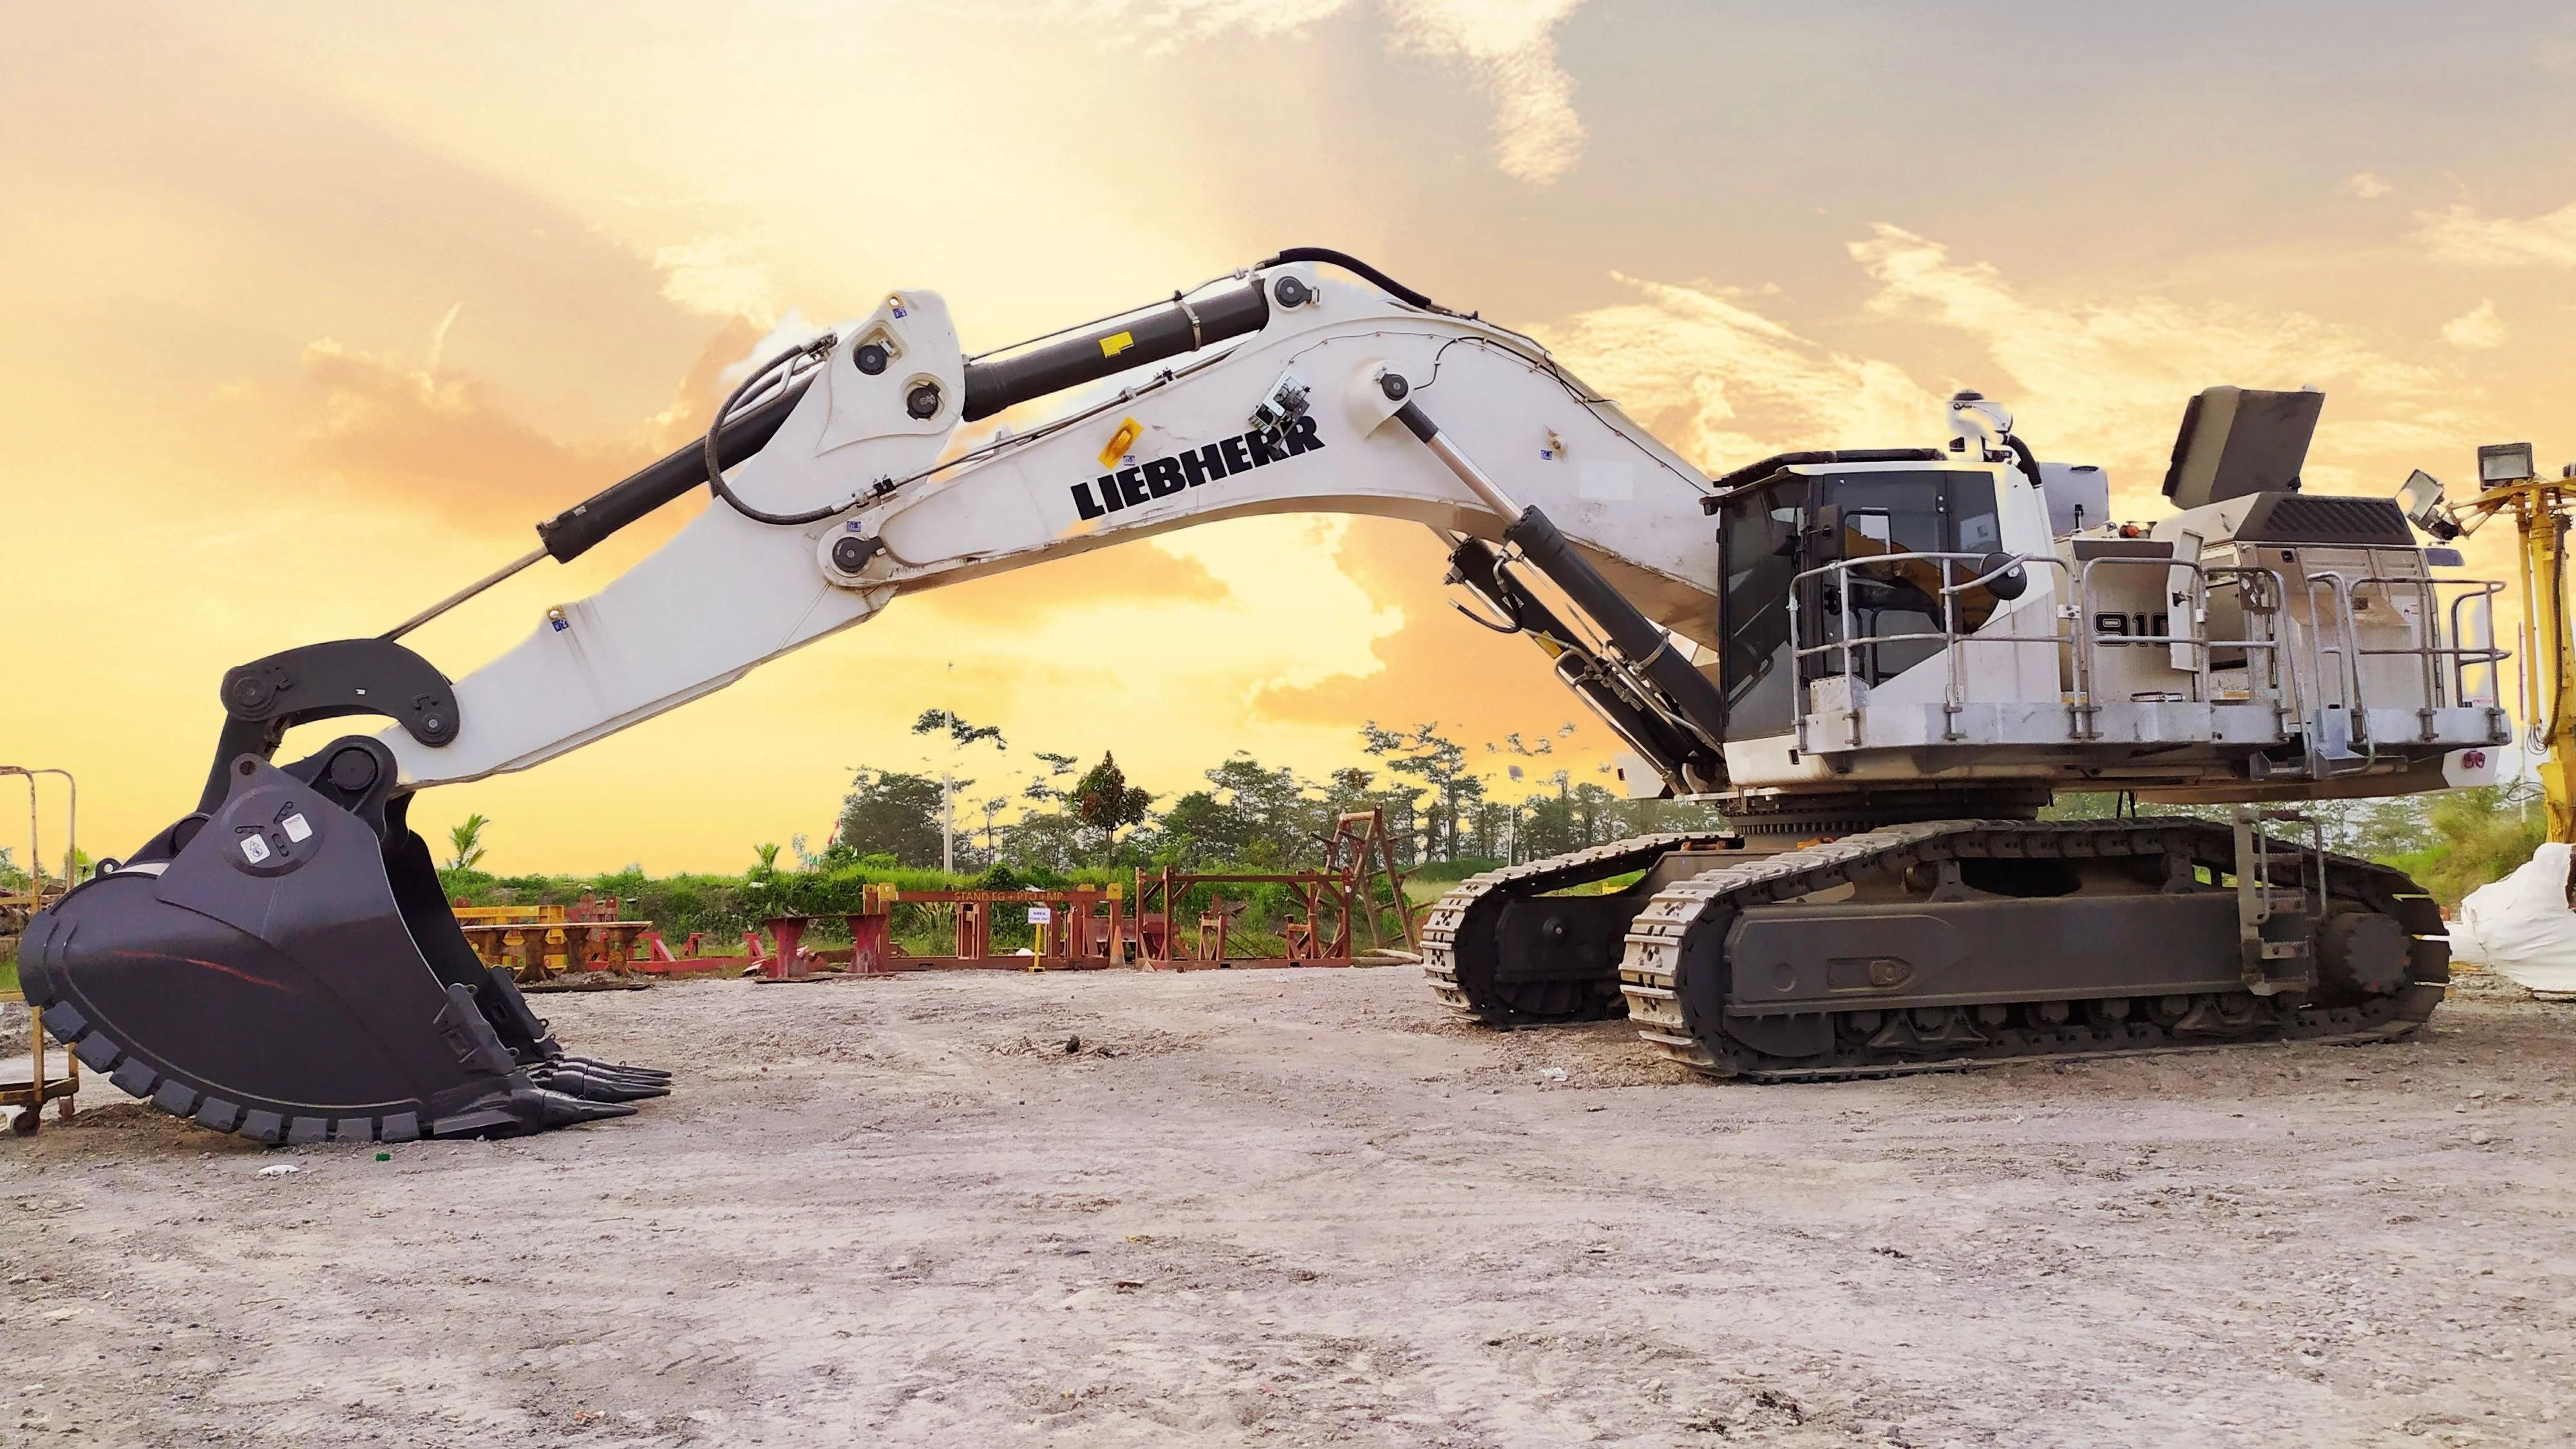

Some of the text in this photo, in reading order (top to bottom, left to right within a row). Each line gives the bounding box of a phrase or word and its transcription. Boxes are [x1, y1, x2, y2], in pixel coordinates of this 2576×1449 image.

[1070, 415, 1326, 521] LIEBHERR
[954, 891, 989, 902] STAND
[992, 891, 1005, 902] EG
[1017, 891, 1037, 902] PTO
